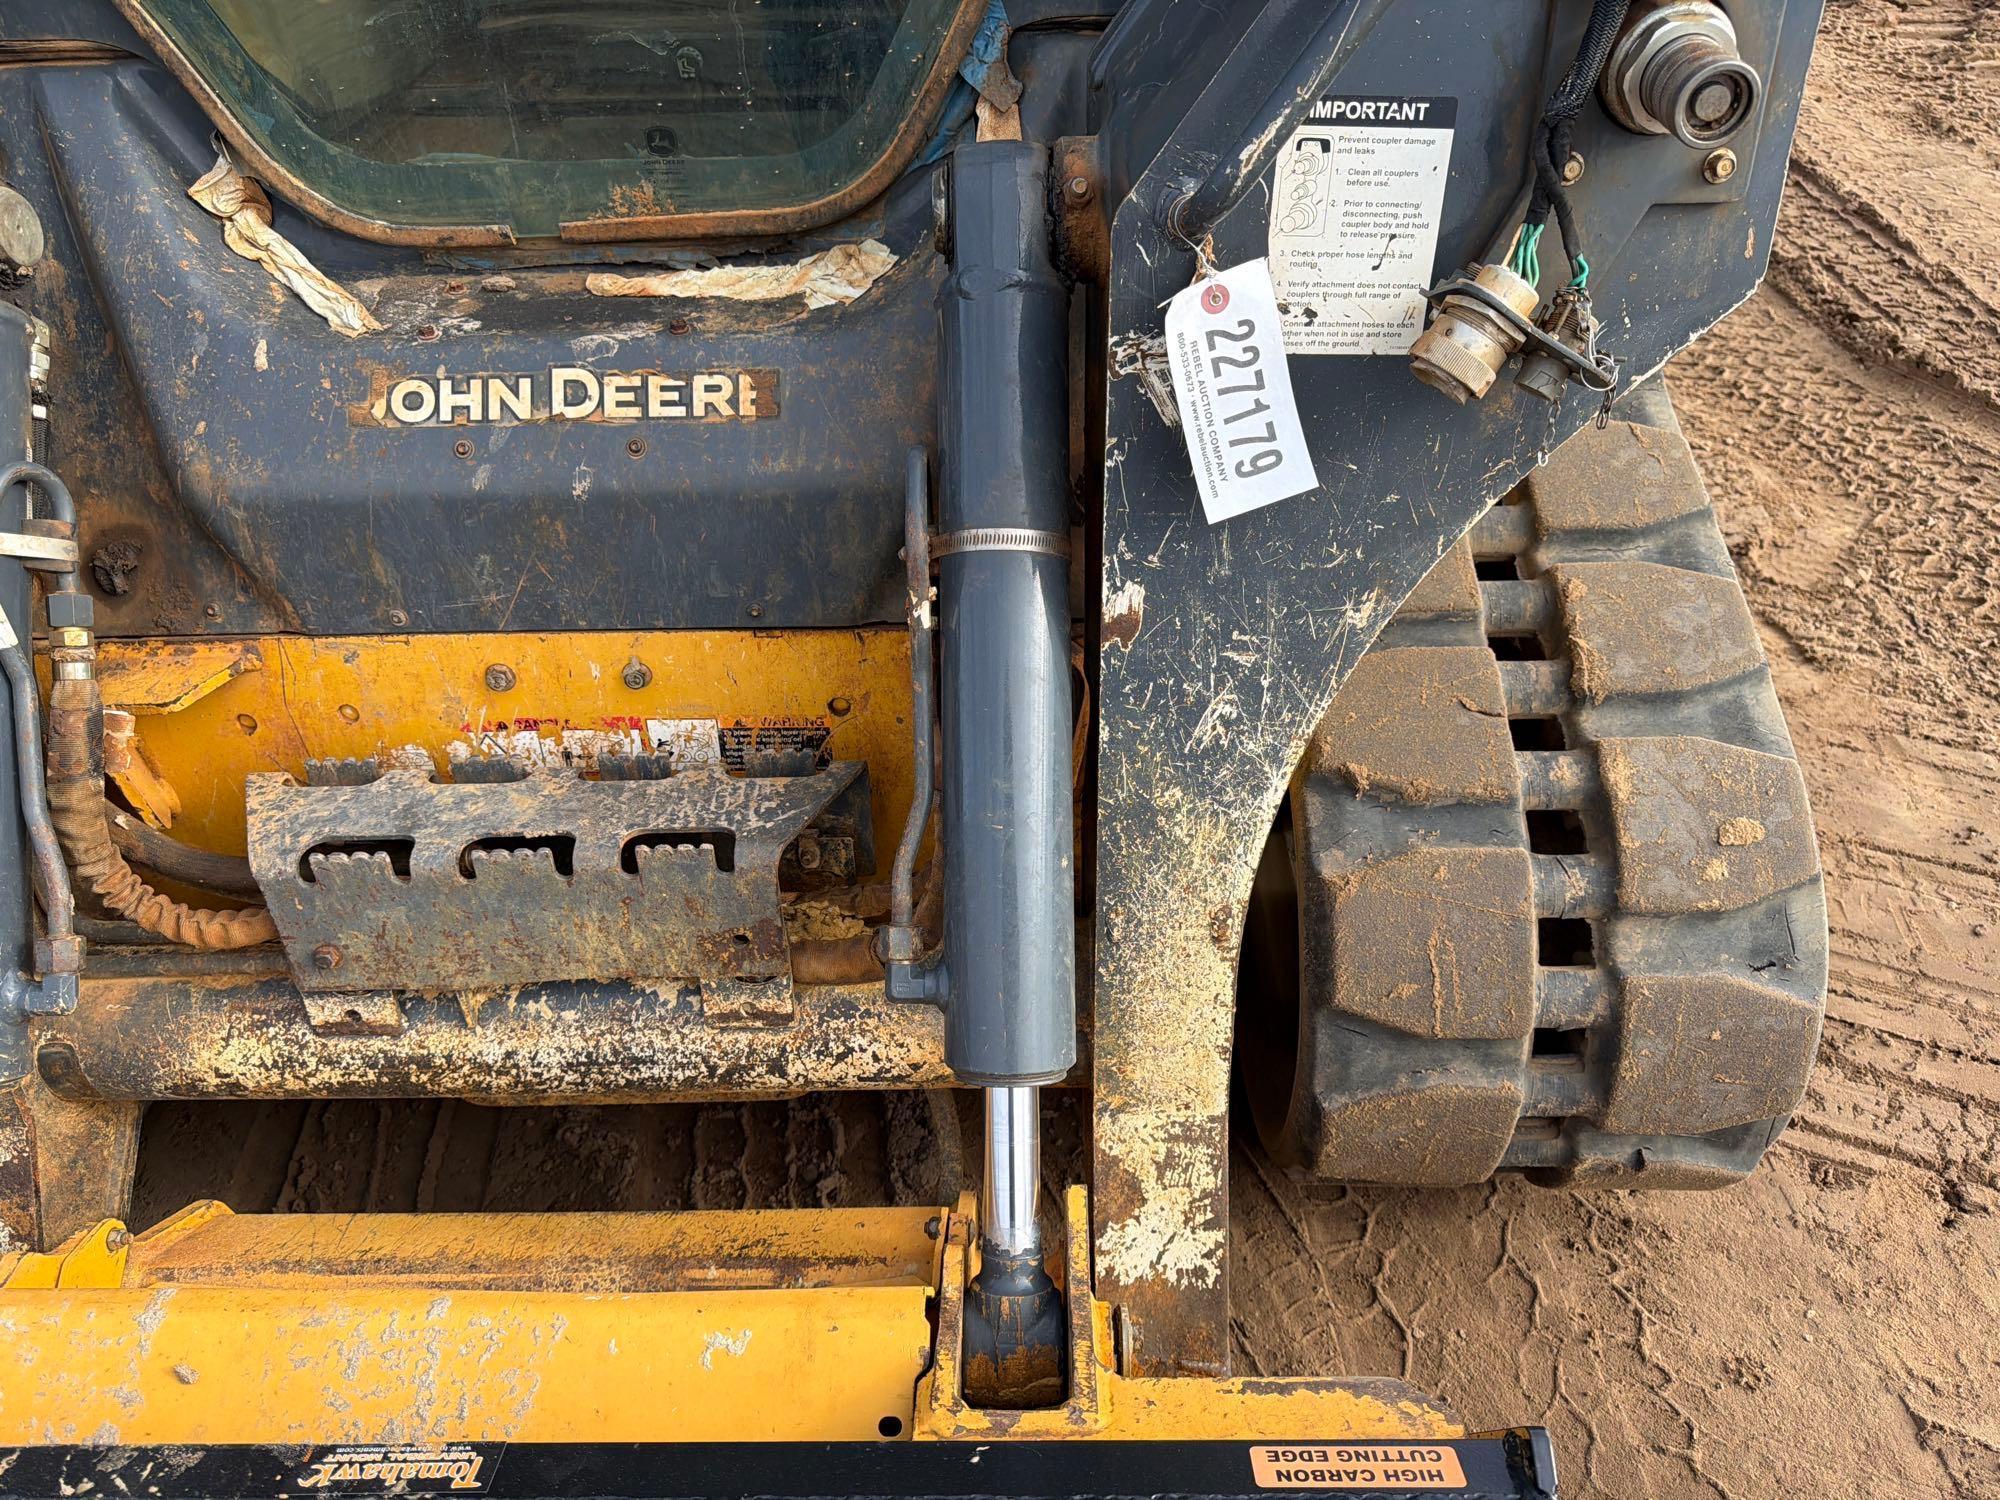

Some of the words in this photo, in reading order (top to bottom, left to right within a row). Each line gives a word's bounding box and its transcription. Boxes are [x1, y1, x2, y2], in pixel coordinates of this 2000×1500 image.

[1309, 101, 1429, 121] IMPORTANT
[1372, 136, 1402, 146] coupler
[1404, 137, 1436, 146] damage
[1385, 169, 1419, 178] couplers
[1375, 201, 1422, 210] connecting/
[1341, 221, 1371, 230] coupler
[1373, 222, 1392, 230] body
[1380, 232, 1416, 240] prsure.
[1291, 250, 1314, 258] Check
[1318, 252, 1343, 260] proper
[1288, 281, 1310, 289] Verify
[1286, 291, 1319, 299] couplers
[1205, 319, 1283, 479] 227179
[1177, 332, 1194, 393] 800-533-0673
[1191, 399, 1219, 499] www.rebelauction.com
[1190, 340, 1202, 377] REBEL
[1199, 380, 1215, 428] AUCTION
[1209, 430, 1229, 483] COMPANY
[323, 1453, 384, 1462] MOUNT
[389, 1452, 477, 1461] UNIVERSAL
[1266, 1450, 1329, 1463] EDGE
[1337, 1450, 1442, 1463] CUTTING
[298, 1456, 483, 1489] Tomahawk
[1276, 1469, 1375, 1482] CARBON
[1385, 1469, 1445, 1482] HIGH
